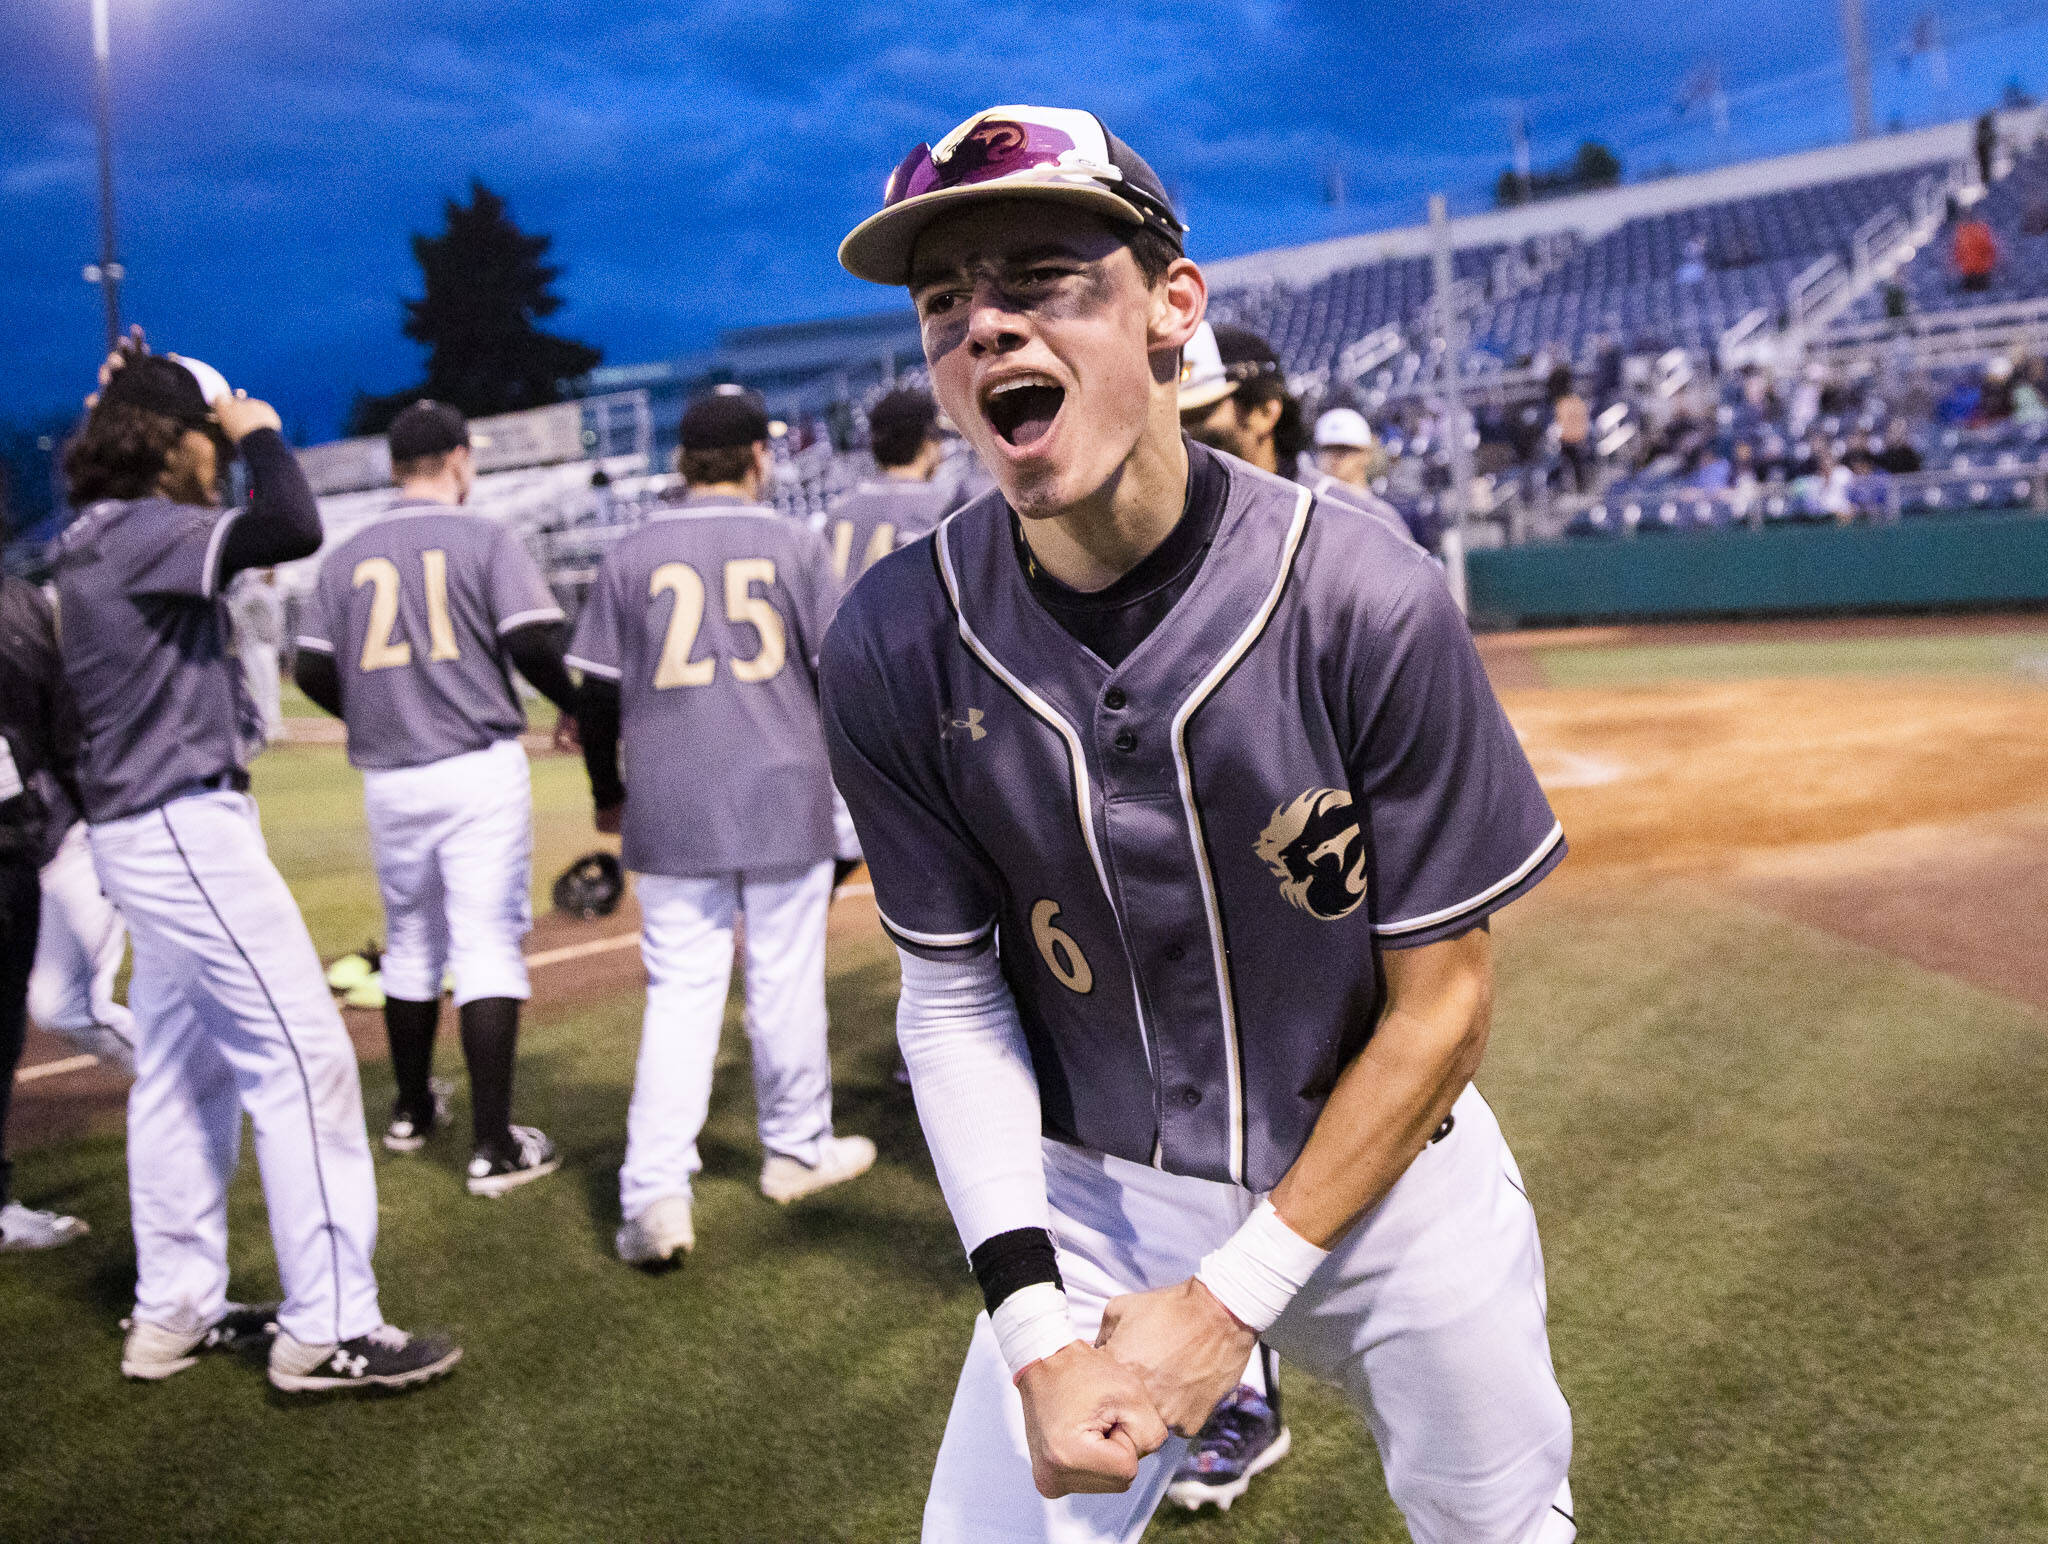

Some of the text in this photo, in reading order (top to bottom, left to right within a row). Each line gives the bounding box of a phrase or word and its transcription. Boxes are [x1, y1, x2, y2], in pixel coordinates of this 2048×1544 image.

[352, 548, 460, 672] 21
[650, 558, 786, 689] 25
[1031, 898, 1093, 994] 6
